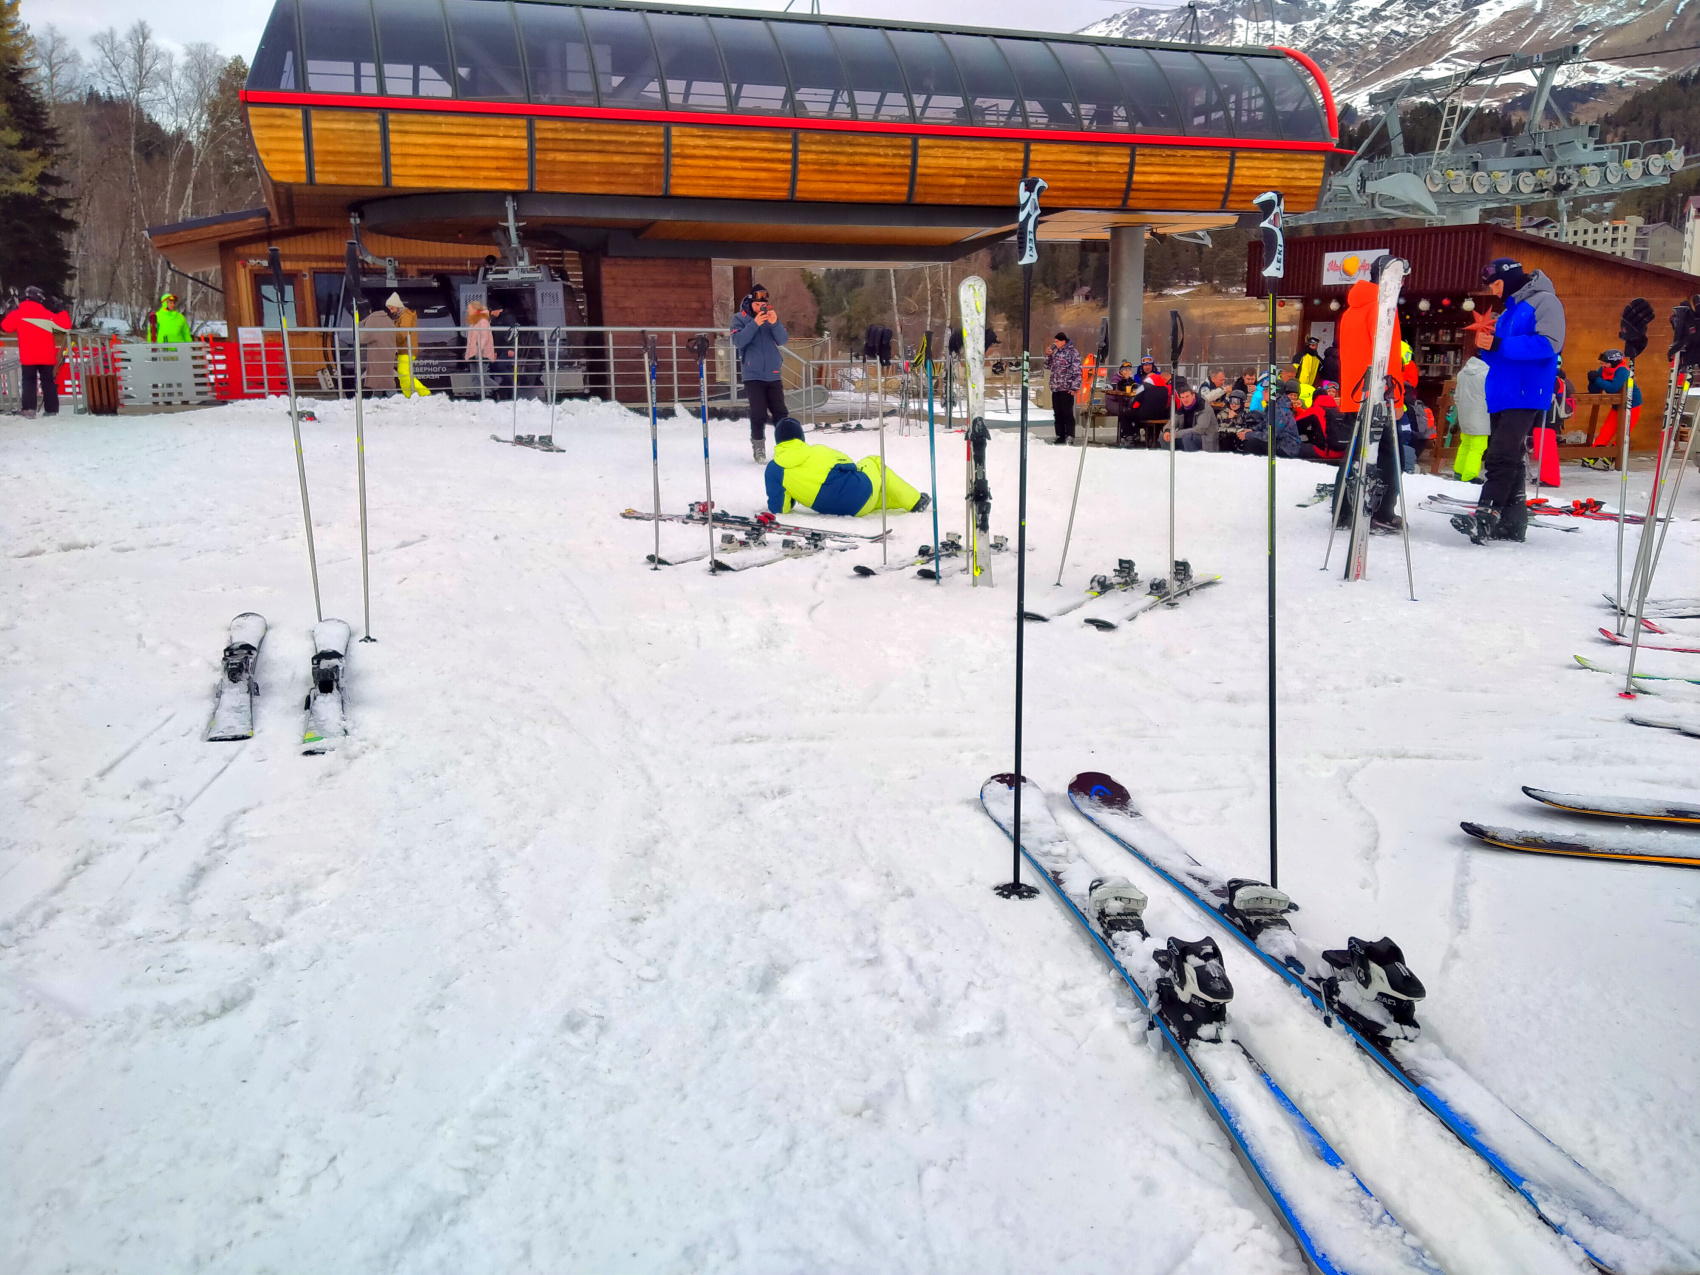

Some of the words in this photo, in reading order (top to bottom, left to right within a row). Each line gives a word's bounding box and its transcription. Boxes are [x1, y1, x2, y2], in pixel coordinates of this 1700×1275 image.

[1275, 243, 1283, 271] LEKI
[1190, 997, 1206, 1008] EAD
[1377, 995, 1397, 1006] EAD
